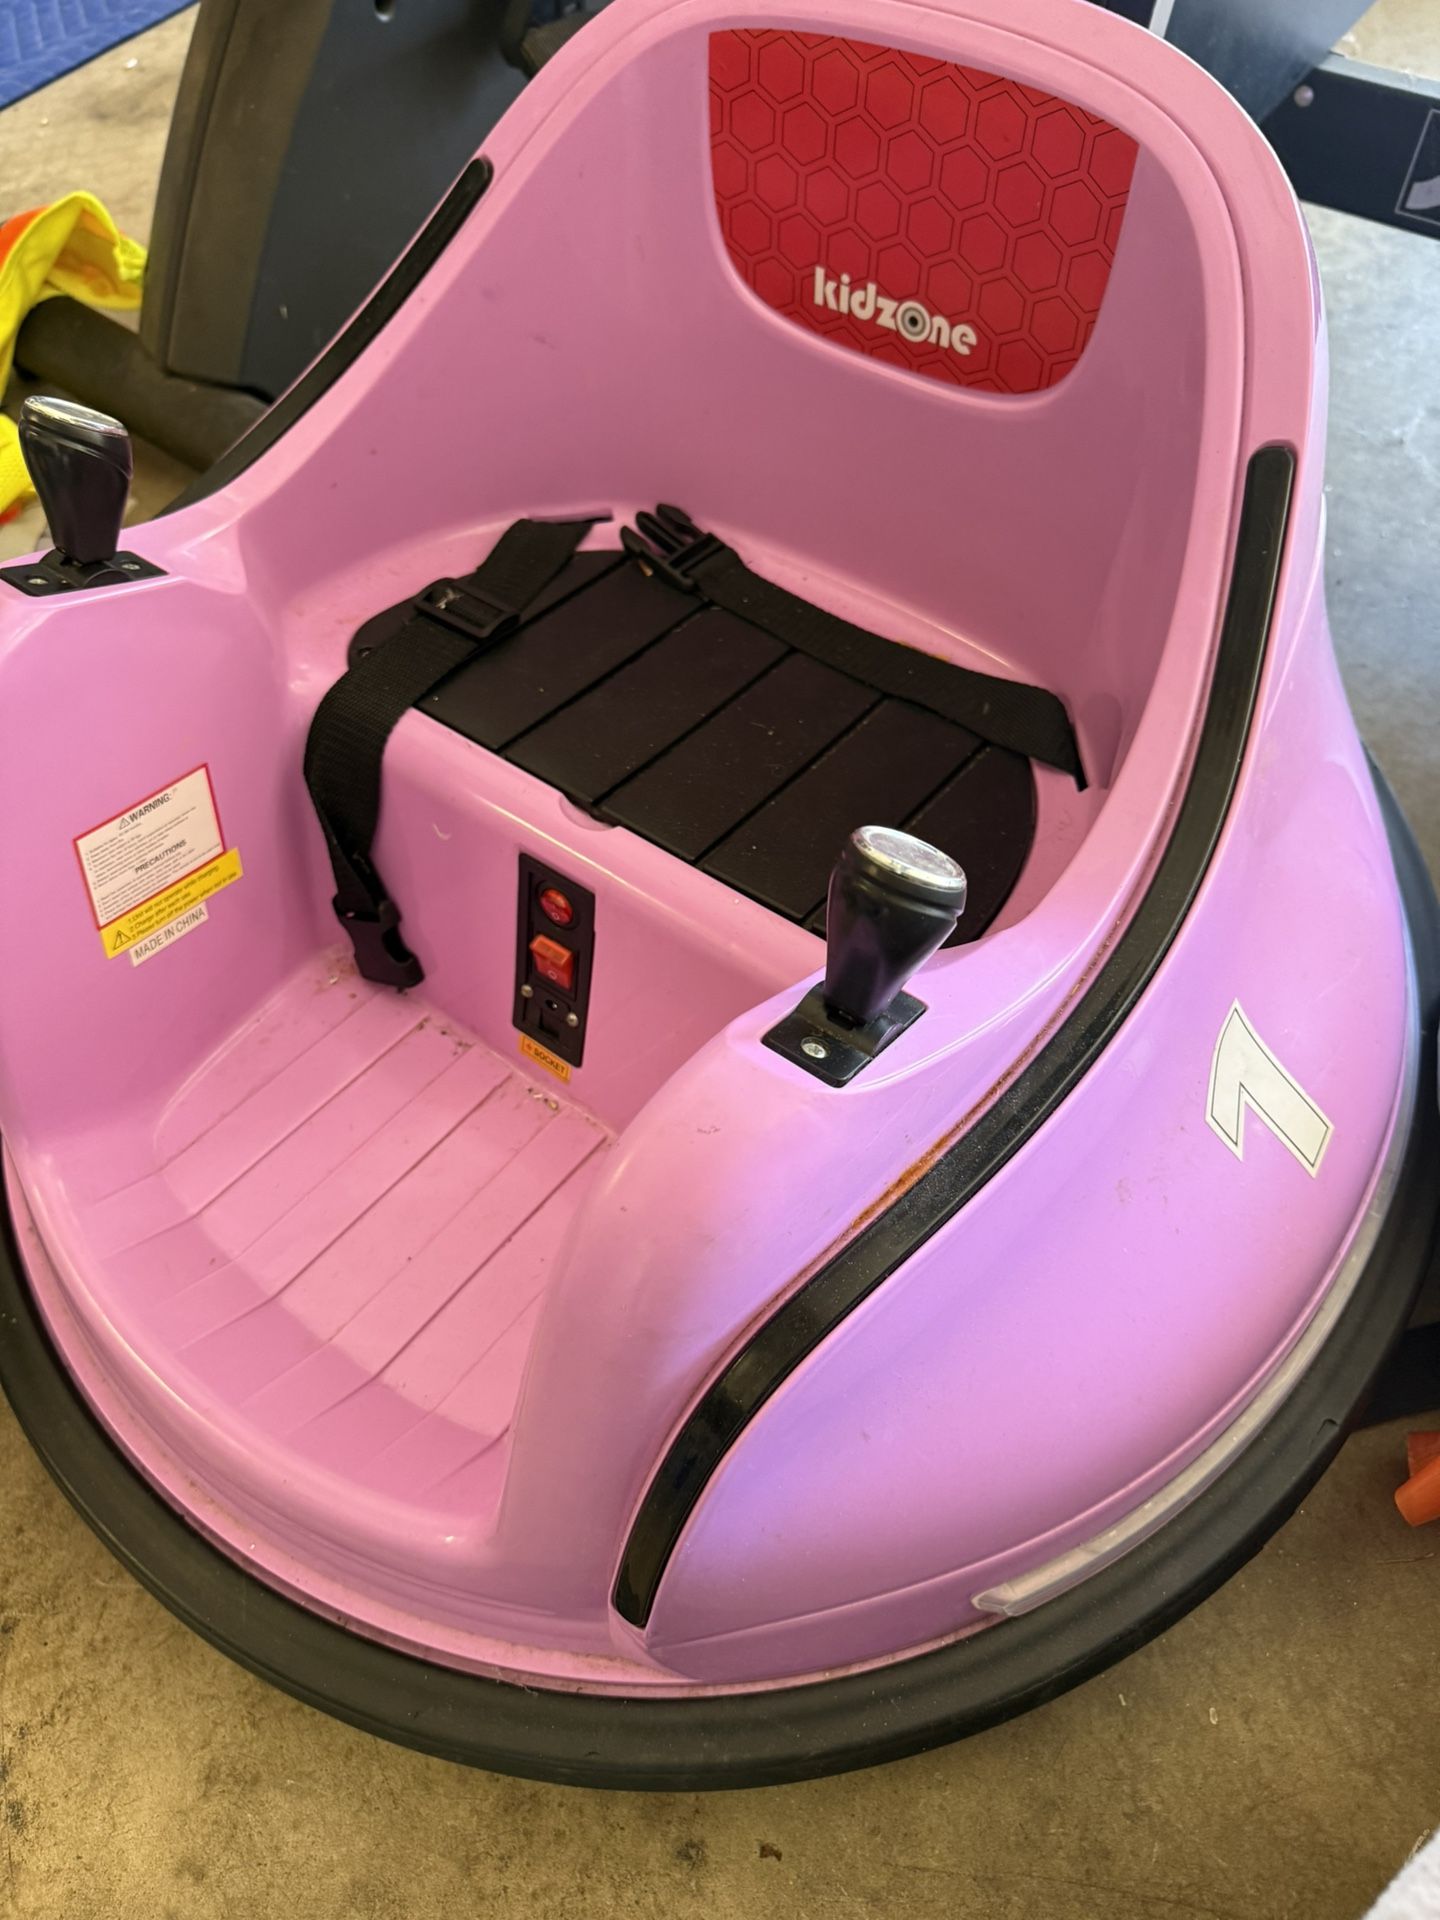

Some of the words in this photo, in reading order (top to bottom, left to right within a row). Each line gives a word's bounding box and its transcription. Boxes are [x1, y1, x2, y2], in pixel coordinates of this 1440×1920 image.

[135, 839, 187, 874] PRECAUTIONS
[134, 935, 163, 959] MADE
[164, 928, 175, 942] IN
[175, 908, 206, 934] CHINA
[533, 1048, 566, 1075] SOCKET
